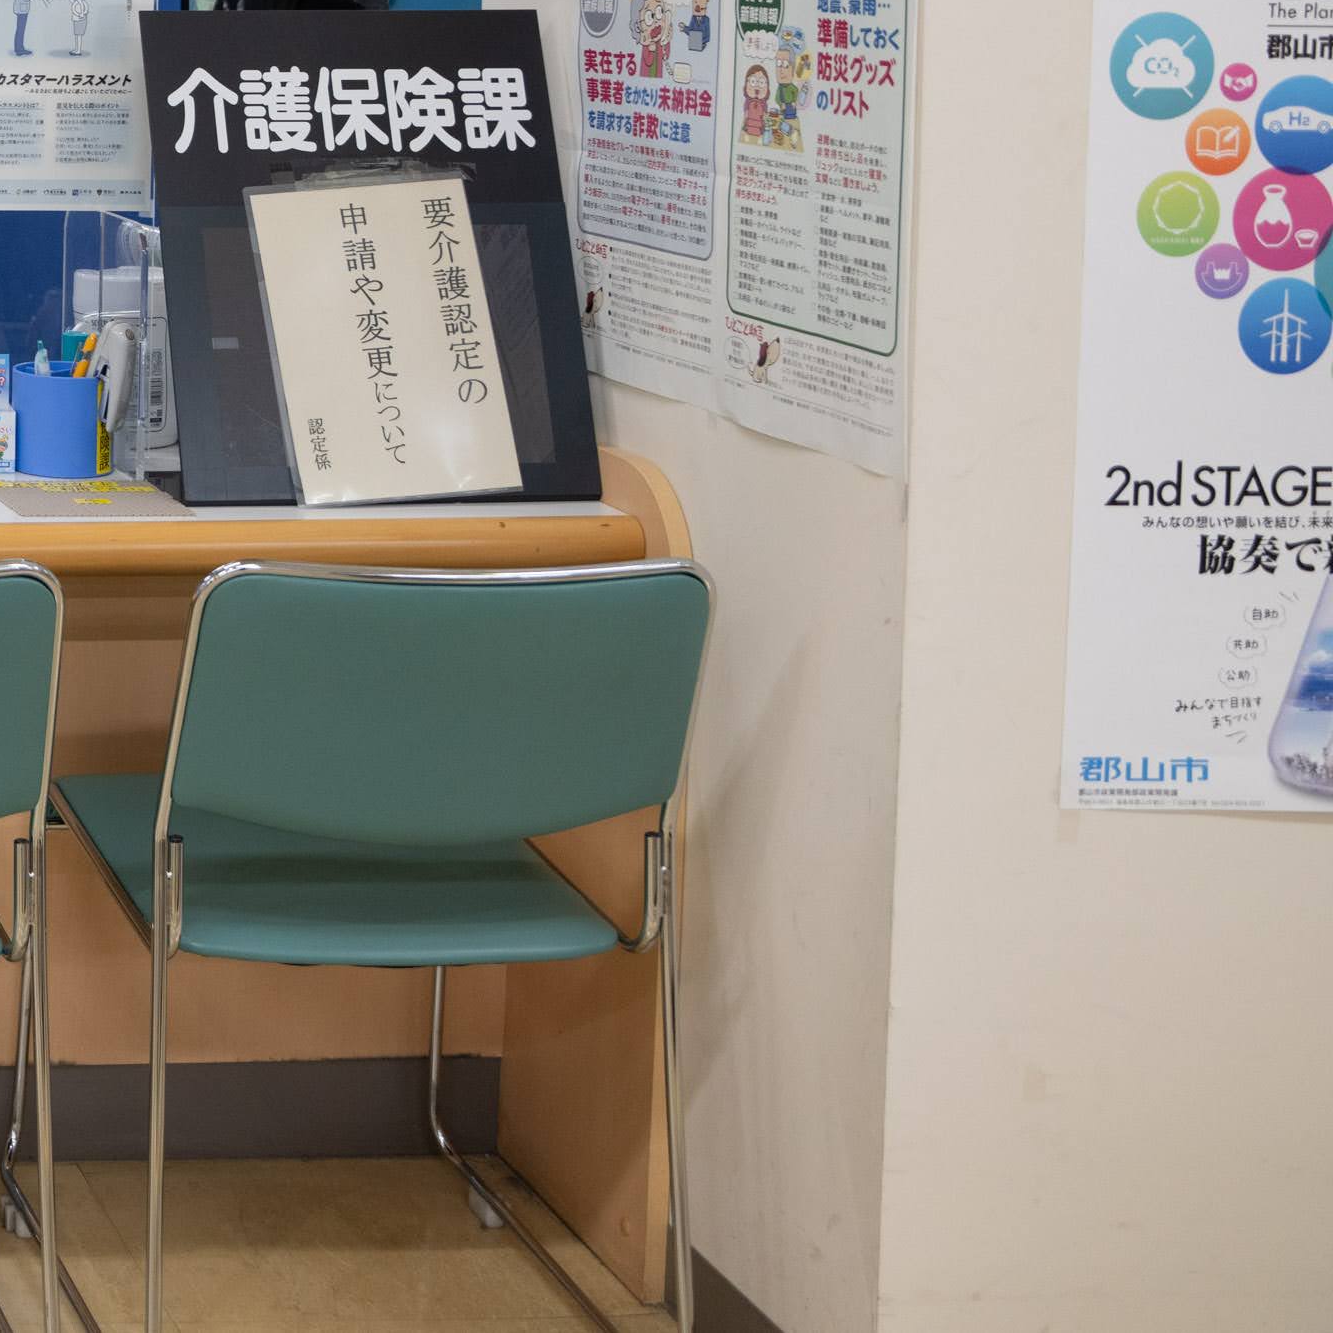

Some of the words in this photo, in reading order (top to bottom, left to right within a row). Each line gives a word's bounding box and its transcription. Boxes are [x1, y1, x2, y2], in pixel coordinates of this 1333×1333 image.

[1269, 2, 1297, 19] The
[817, 18, 900, 50] 準備しておく
[583, 49, 637, 76] 実在する
[817, 52, 895, 86] 防災グッズ
[167, 66, 536, 154] 介護保険課
[585, 77, 712, 117] 事業者をかたり未納料金
[816, 88, 870, 118] のリスト
[588, 111, 691, 144] を請求する詐欺に注意
[421, 197, 488, 405] 要介護認定の
[340, 203, 406, 465] 申請や変更について
[308, 418, 332, 470] 認定係
[1104, 460, 1183, 507] 2nd
[1190, 465, 1333, 507] STAGE
[1252, 607, 1279, 622] 自助
[1233, 639, 1259, 651] 共助
[1226, 669, 1251, 683] 公助
[1174, 696, 1263, 714] みんなで目指す
[1079, 756, 1209, 784] 郡山市
